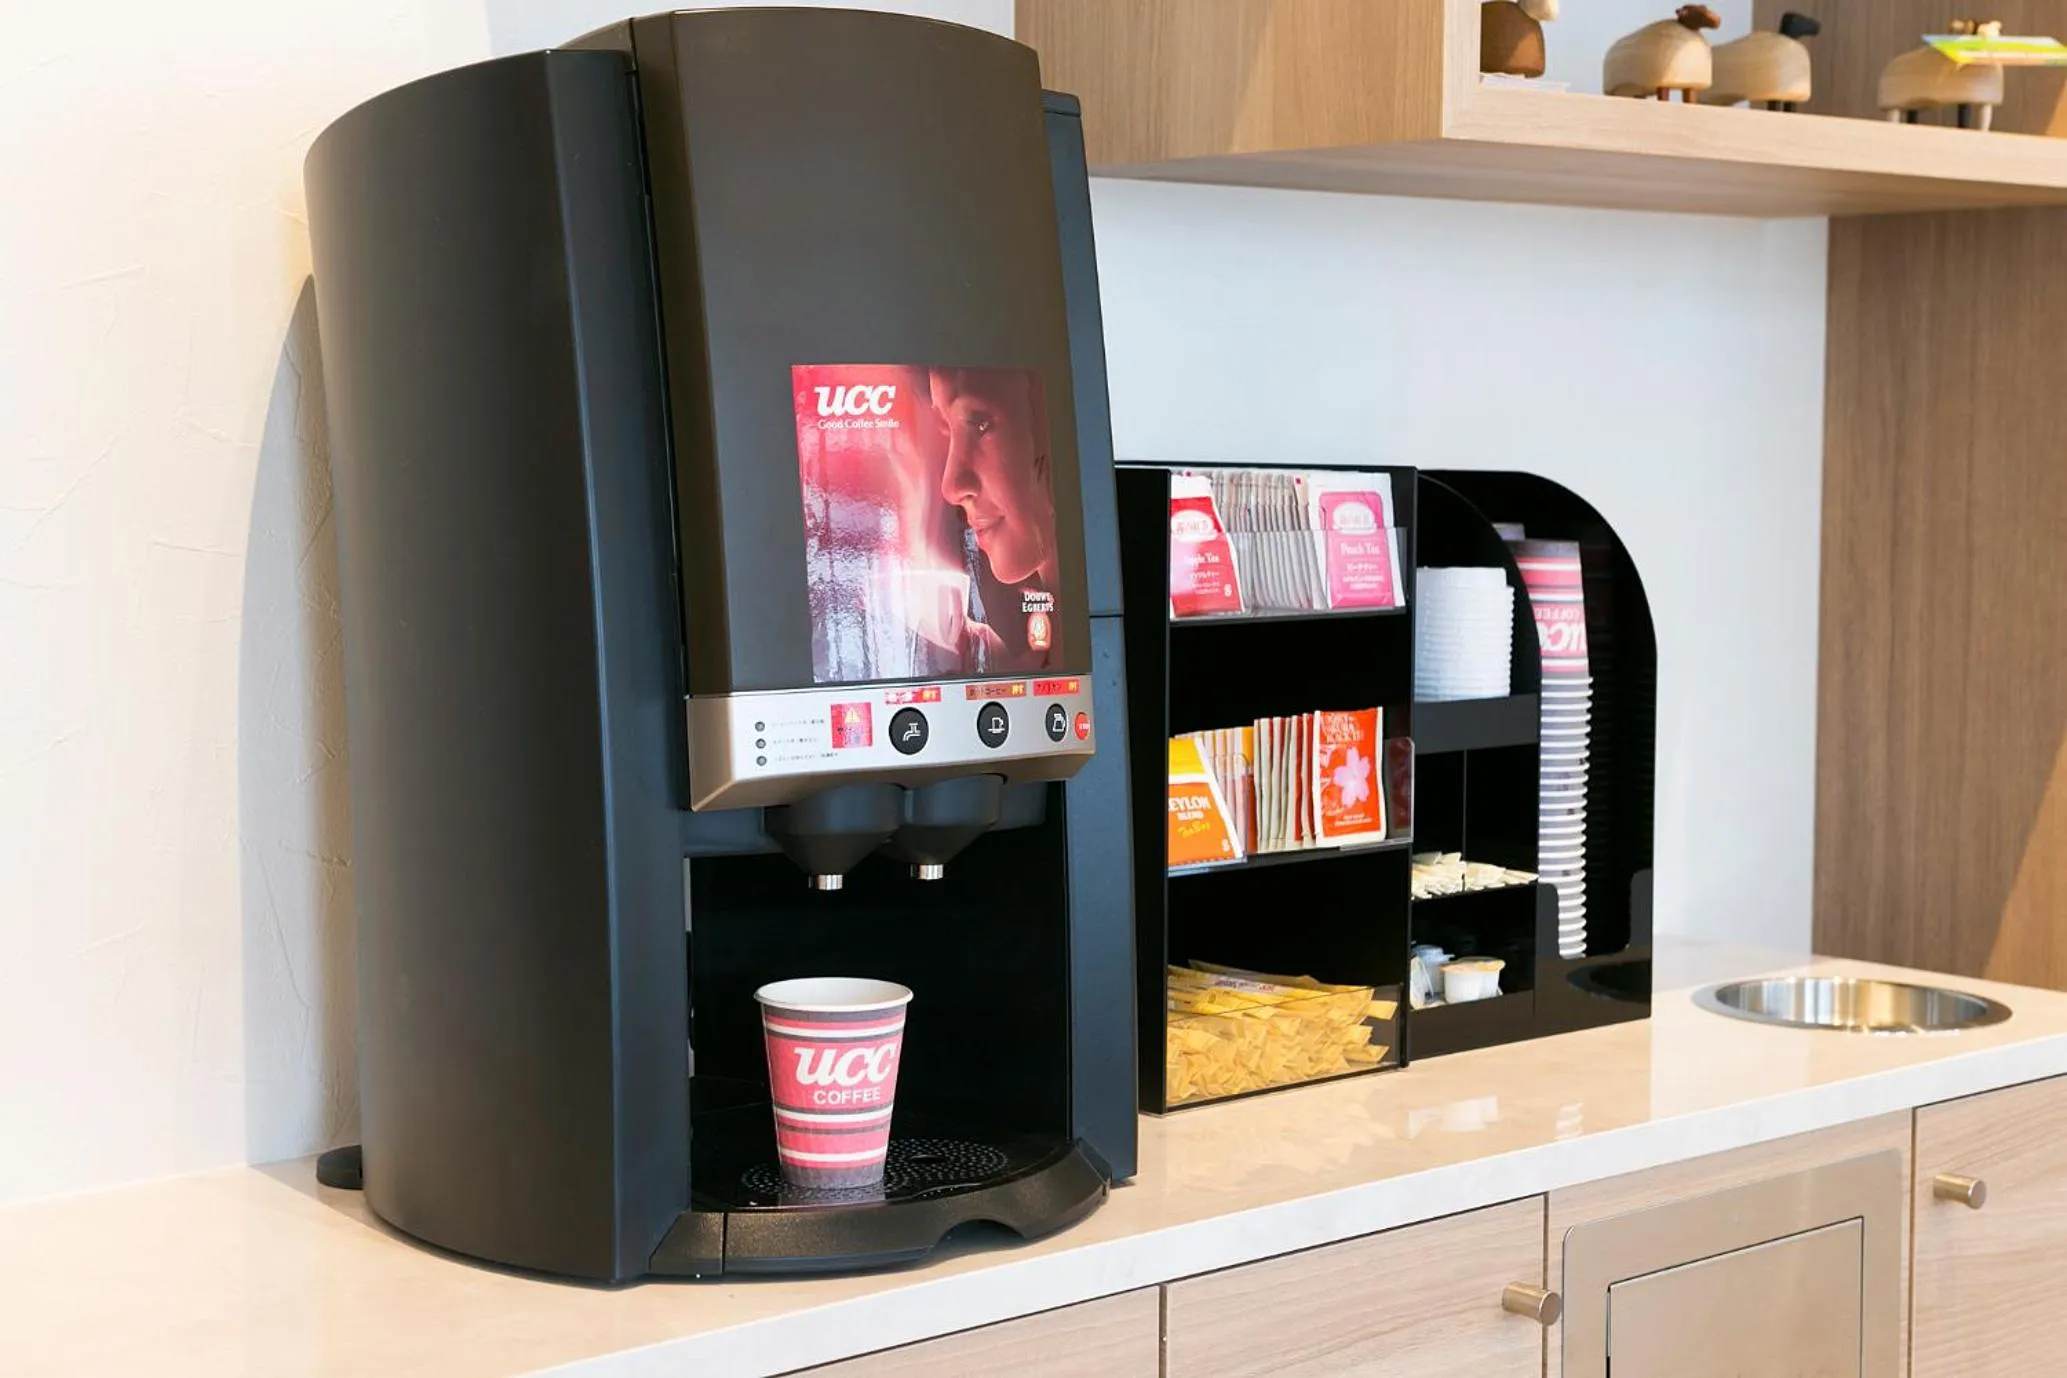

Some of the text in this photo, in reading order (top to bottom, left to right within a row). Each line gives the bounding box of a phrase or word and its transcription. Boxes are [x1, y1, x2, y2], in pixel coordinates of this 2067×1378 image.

[817, 417, 900, 430] Good Coffee Smile
[1168, 796, 1212, 811] EYLON
[813, 1087, 881, 1105] COFFEE
